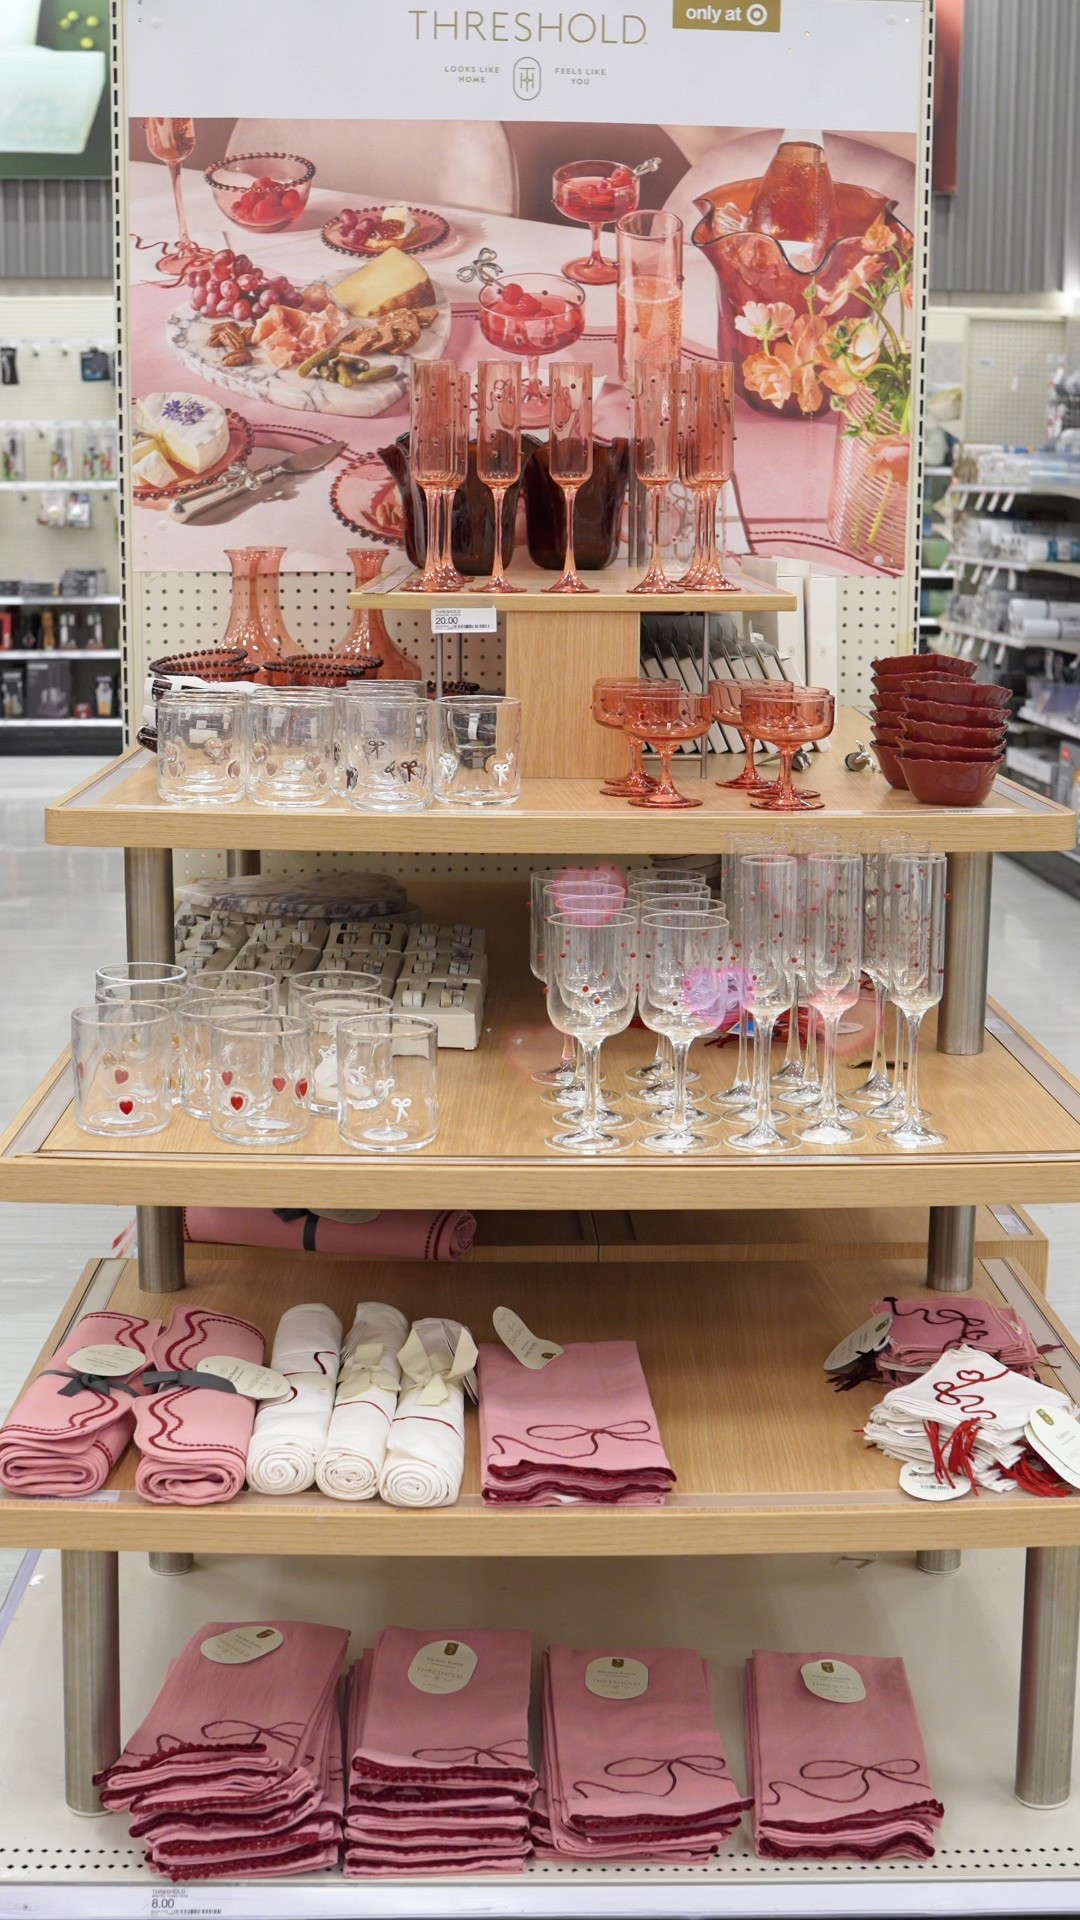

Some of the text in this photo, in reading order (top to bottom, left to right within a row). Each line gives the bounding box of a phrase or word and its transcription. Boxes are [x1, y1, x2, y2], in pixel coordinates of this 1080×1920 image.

[685, 4, 742, 23] only at
[408, 10, 647, 45] THRESHOLD
[444, 65, 500, 74] LOOKS LIKE
[554, 67, 607, 76] FEELS LIKE
[458, 76, 486, 84] HOME
[571, 78, 590, 86] YOU
[435, 616, 459, 625] 20.00
[151, 1898, 175, 1909] 8.00
